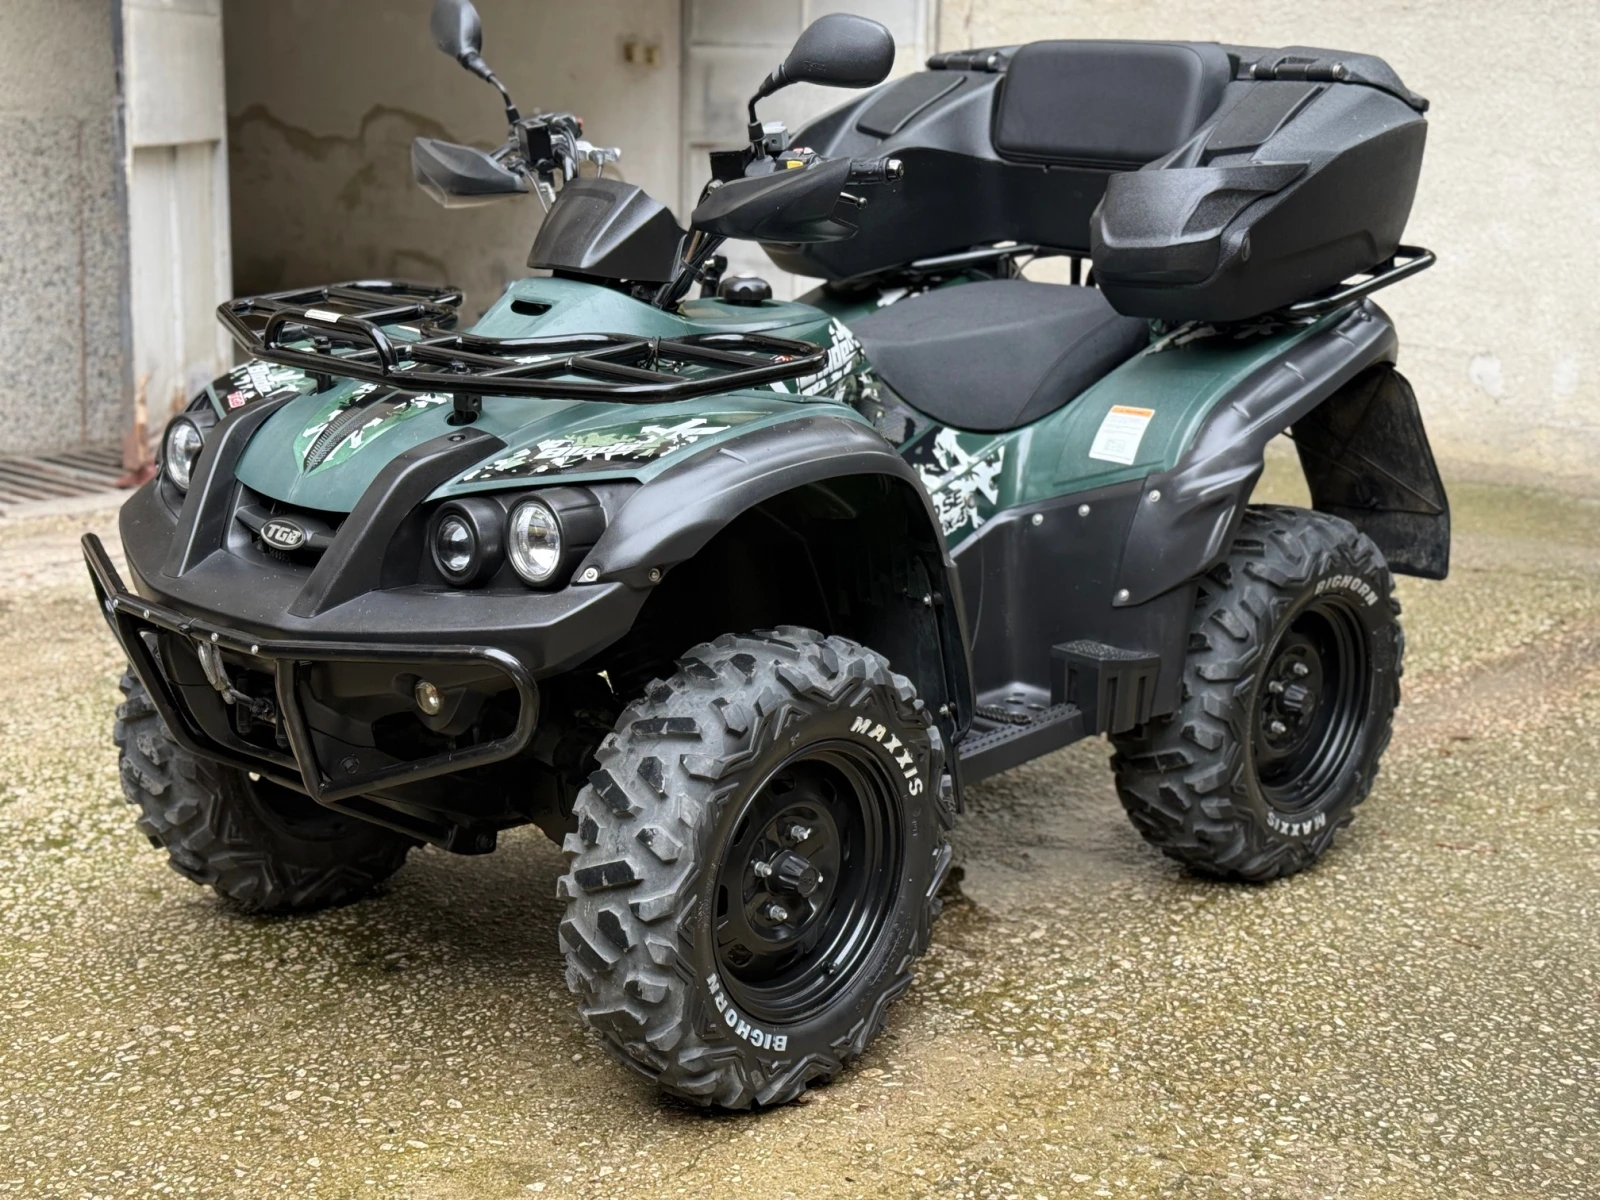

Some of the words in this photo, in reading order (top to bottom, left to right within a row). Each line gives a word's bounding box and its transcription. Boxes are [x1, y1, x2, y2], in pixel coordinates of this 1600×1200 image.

[942, 488, 964, 515] SE
[267, 523, 302, 545] TGB
[1314, 574, 1379, 607] BIGHORN
[850, 716, 924, 796] MAXXIS
[1266, 811, 1327, 837] MAXXIS
[706, 973, 788, 1052] BIGHORN
